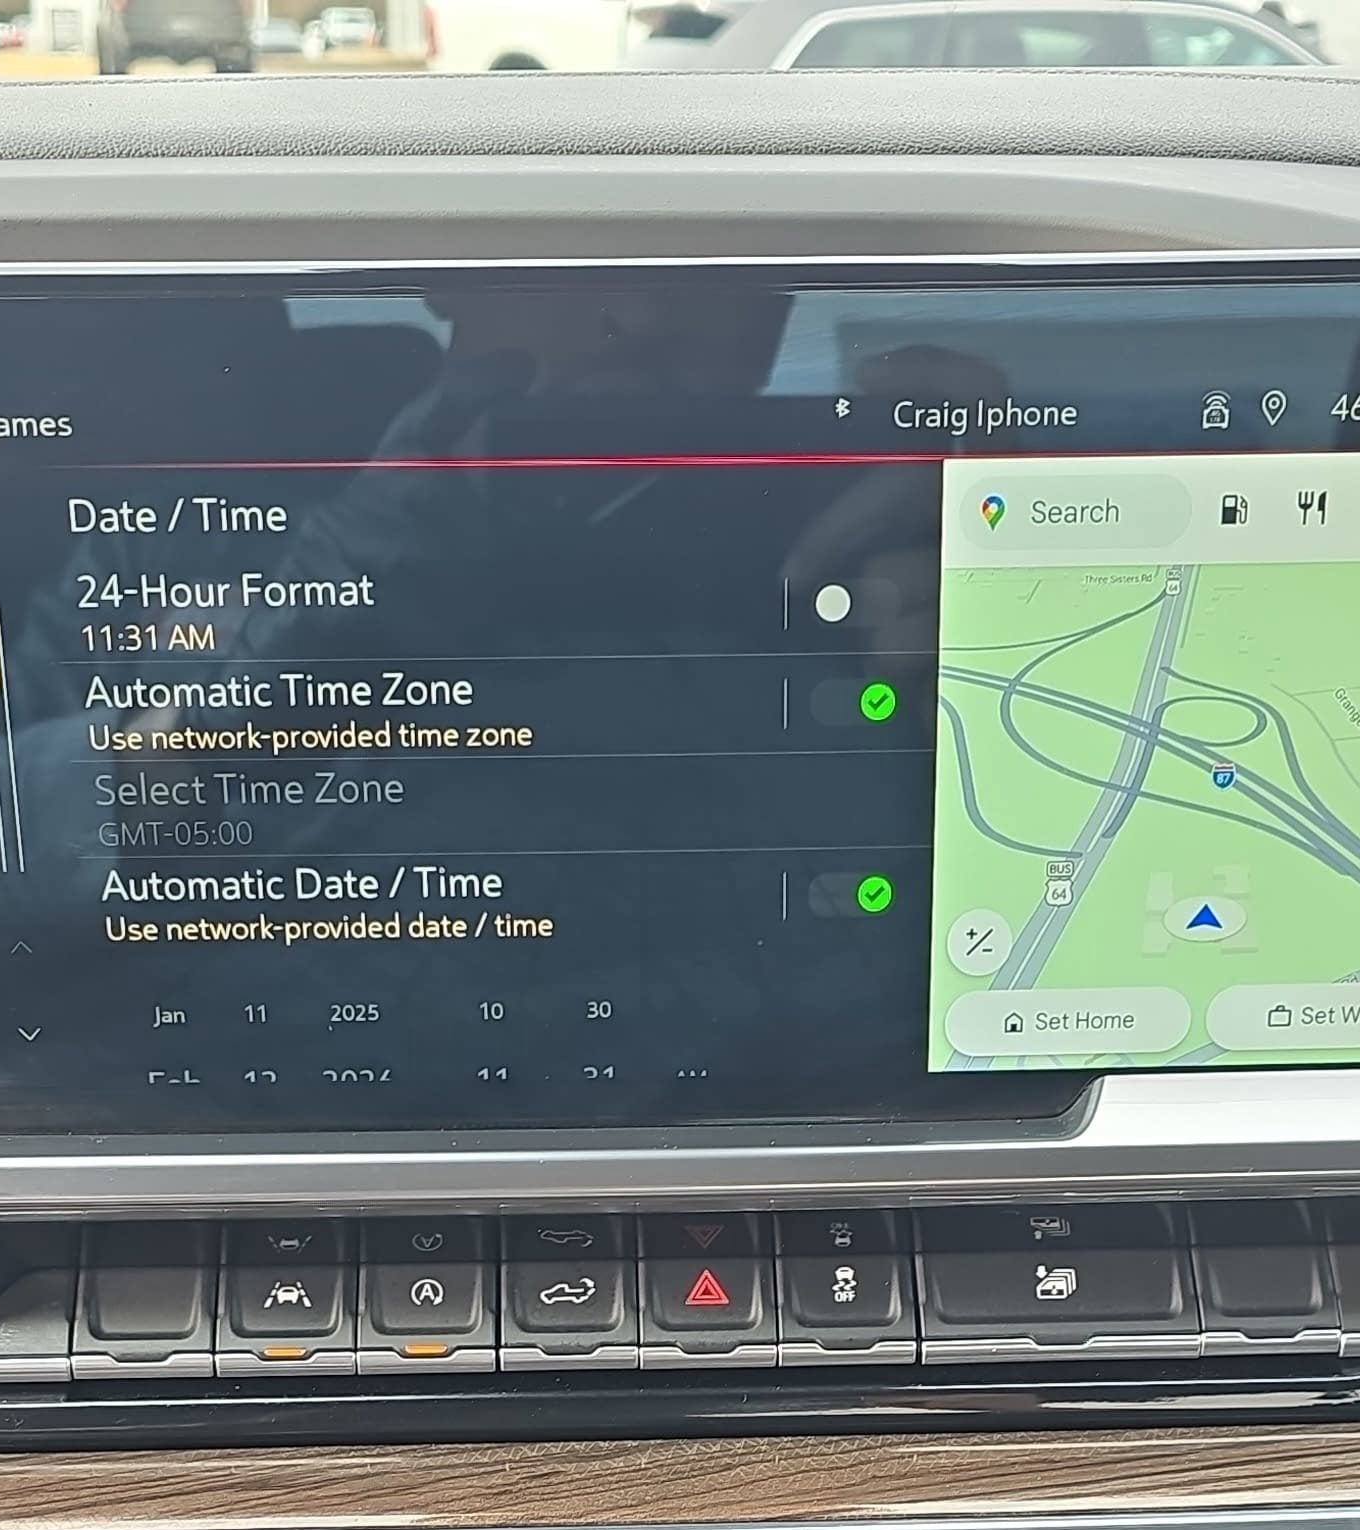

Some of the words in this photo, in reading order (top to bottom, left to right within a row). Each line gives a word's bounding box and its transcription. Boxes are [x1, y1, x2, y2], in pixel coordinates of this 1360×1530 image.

[893, 402, 968, 434] Craig
[975, 402, 1079, 432] Iphone
[68, 498, 157, 534] Date
[166, 497, 185, 534] /
[192, 497, 288, 534] Time
[1031, 499, 1121, 526] Search
[76, 574, 230, 609] 24-Hour
[241, 572, 375, 607] Format
[81, 624, 159, 652] 11:31
[167, 624, 216, 651] AM
[84, 674, 271, 710] Automatic
[280, 673, 374, 707] Time
[382, 672, 474, 707] Zone
[88, 724, 143, 751] Use
[151, 722, 391, 755] network-provided
[397, 723, 460, 749] time
[466, 727, 533, 749] zone
[94, 773, 205, 808] Select
[213, 772, 307, 806] Time
[314, 772, 405, 806] Zone
[98, 821, 254, 849] GMT-05:00
[1049, 863, 1072, 874] BUS
[101, 868, 285, 903] Automatic
[295, 866, 380, 901] Date
[389, 866, 405, 901] /
[412, 866, 503, 900] Time
[1051, 887, 1067, 901] 64
[105, 915, 159, 942] Use
[166, 913, 401, 947] network-provided
[407, 913, 468, 940] date
[474, 913, 489, 940] /
[493, 912, 554, 939] time
[152, 1005, 187, 1029] Jan
[243, 1004, 268, 1023] 11
[330, 1004, 381, 1023] 2025
[479, 1002, 504, 1021] 10
[586, 1000, 613, 1019] 30
[1034, 1011, 1071, 1032] Set
[1075, 1009, 1135, 1031] Home
[1300, 1005, 1335, 1026] Set
[833, 1290, 857, 1303] OFF
